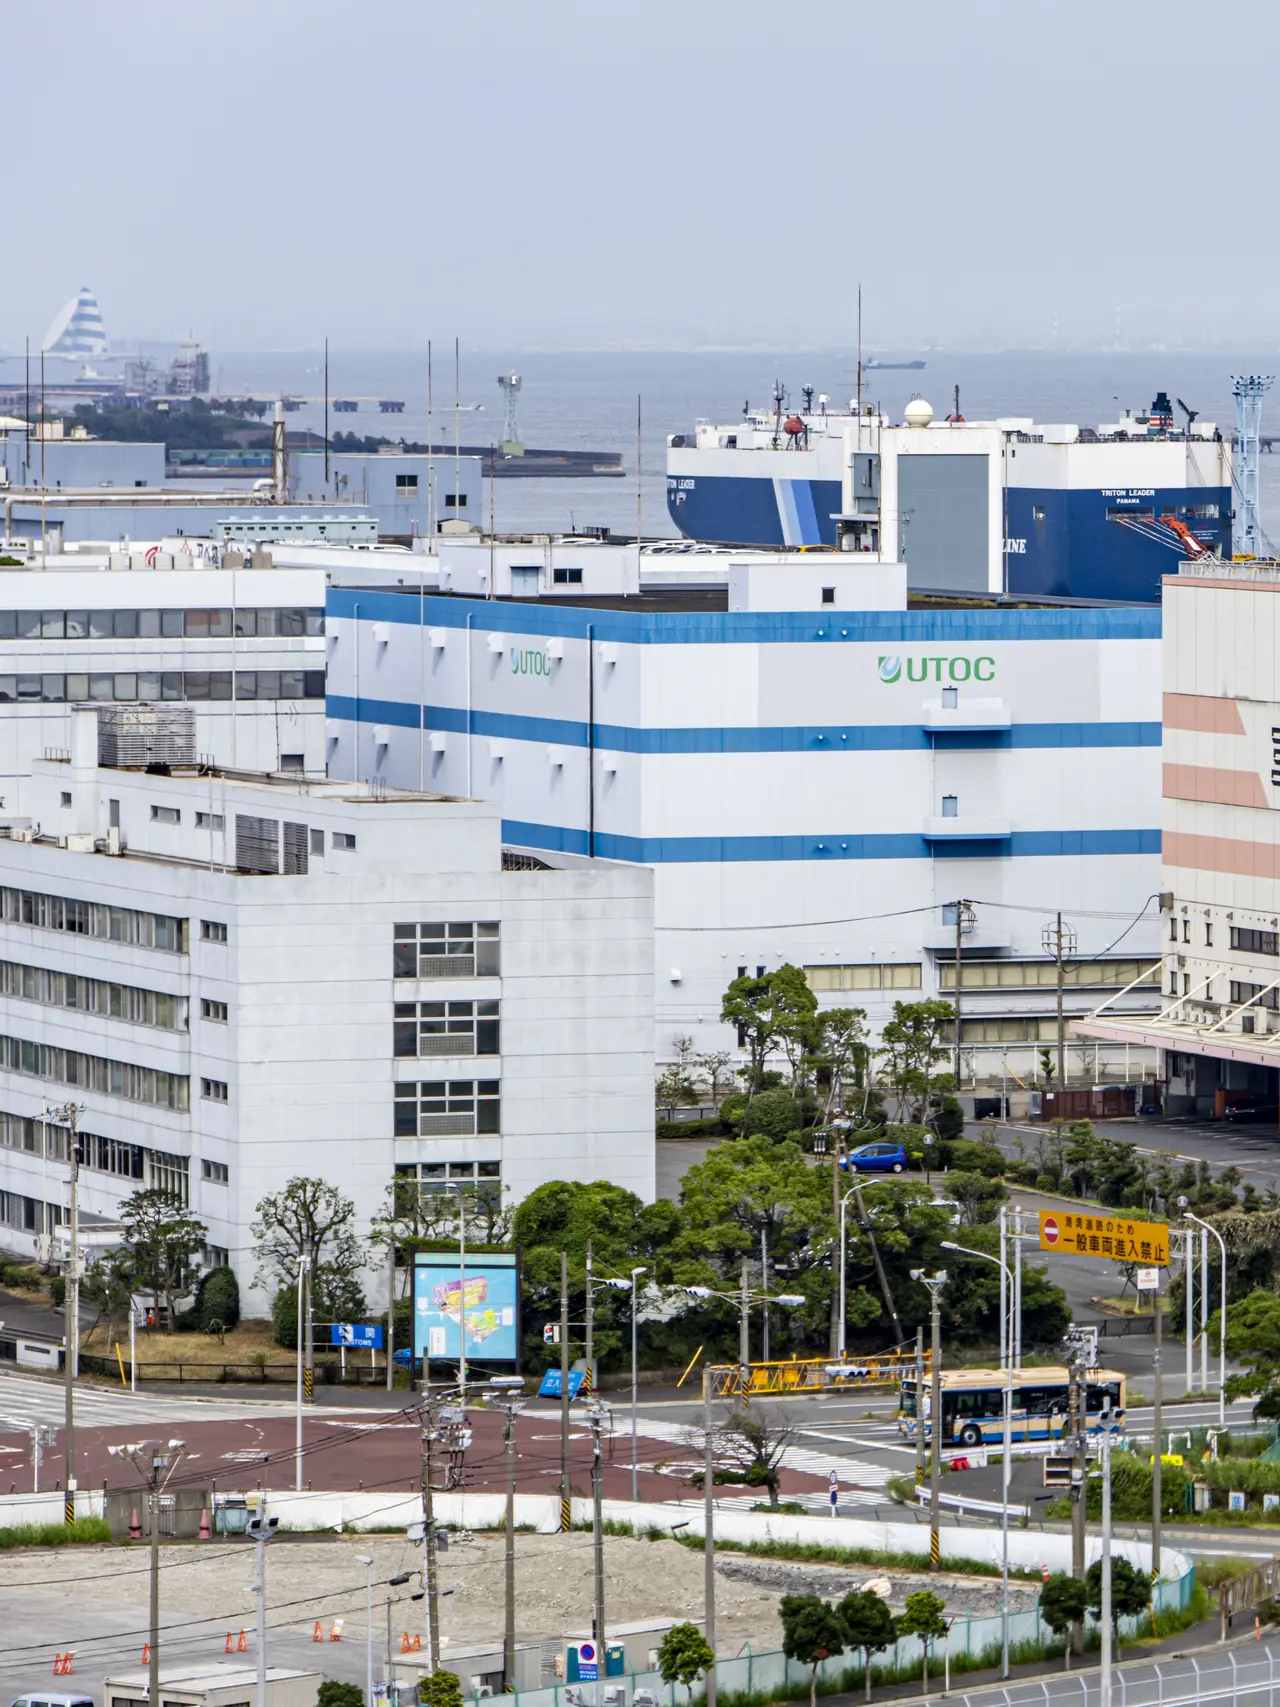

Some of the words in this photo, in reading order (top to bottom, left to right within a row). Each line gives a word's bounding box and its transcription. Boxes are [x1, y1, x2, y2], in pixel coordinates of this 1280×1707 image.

[520, 650, 551, 676] UTOC
[907, 656, 995, 682] UTOC
[1065, 1216, 1134, 1236] 港湾道路のため
[1063, 1233, 1165, 1262] 一般車両進入禁止
